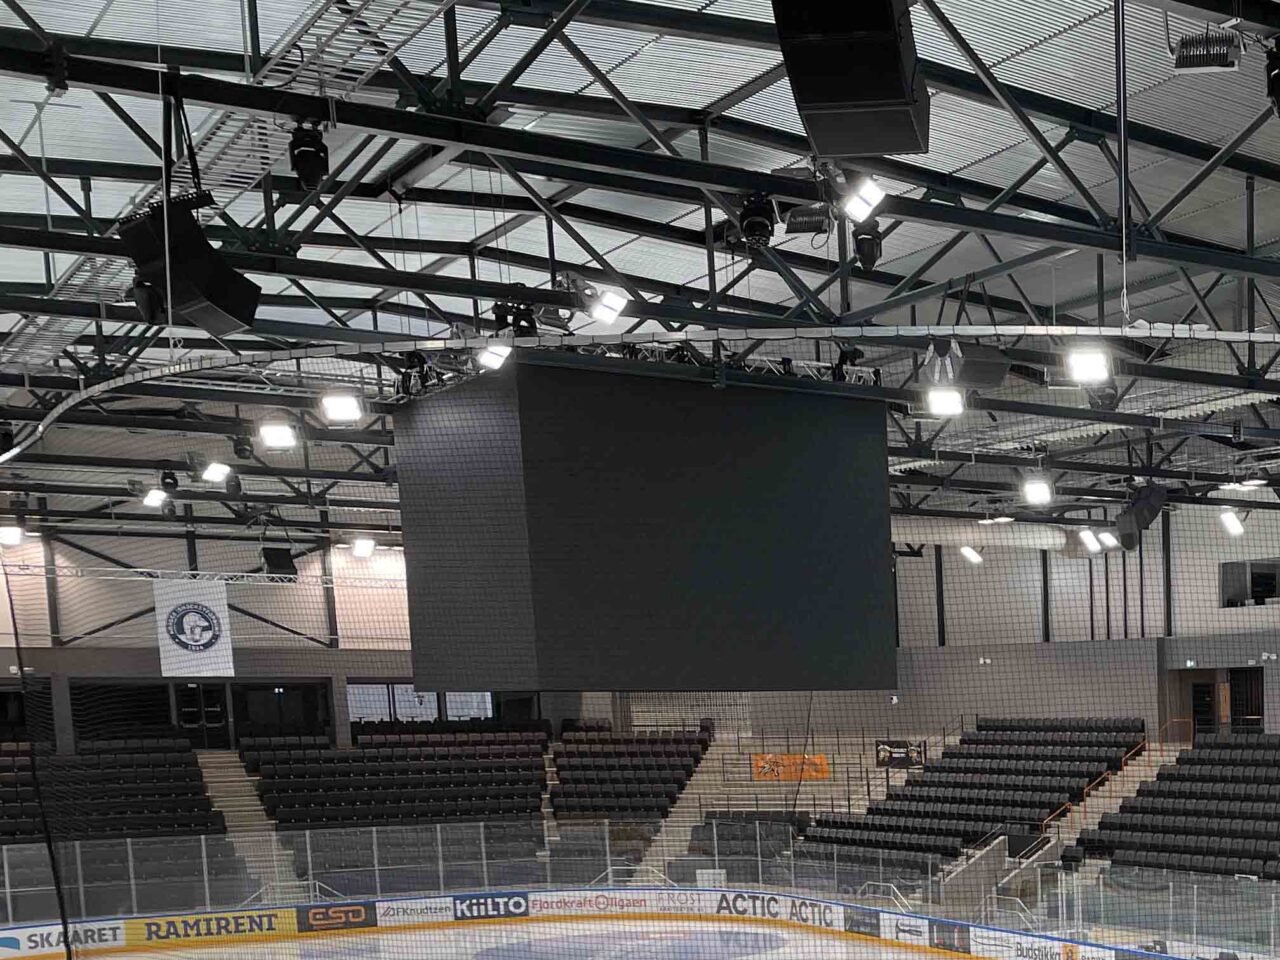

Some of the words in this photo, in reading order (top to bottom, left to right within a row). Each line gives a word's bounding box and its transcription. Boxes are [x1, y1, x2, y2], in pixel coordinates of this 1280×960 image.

[716, 893, 779, 918] ACTIC
[789, 900, 833, 927] ACTIC
[145, 912, 279, 942] RAMIRENT
